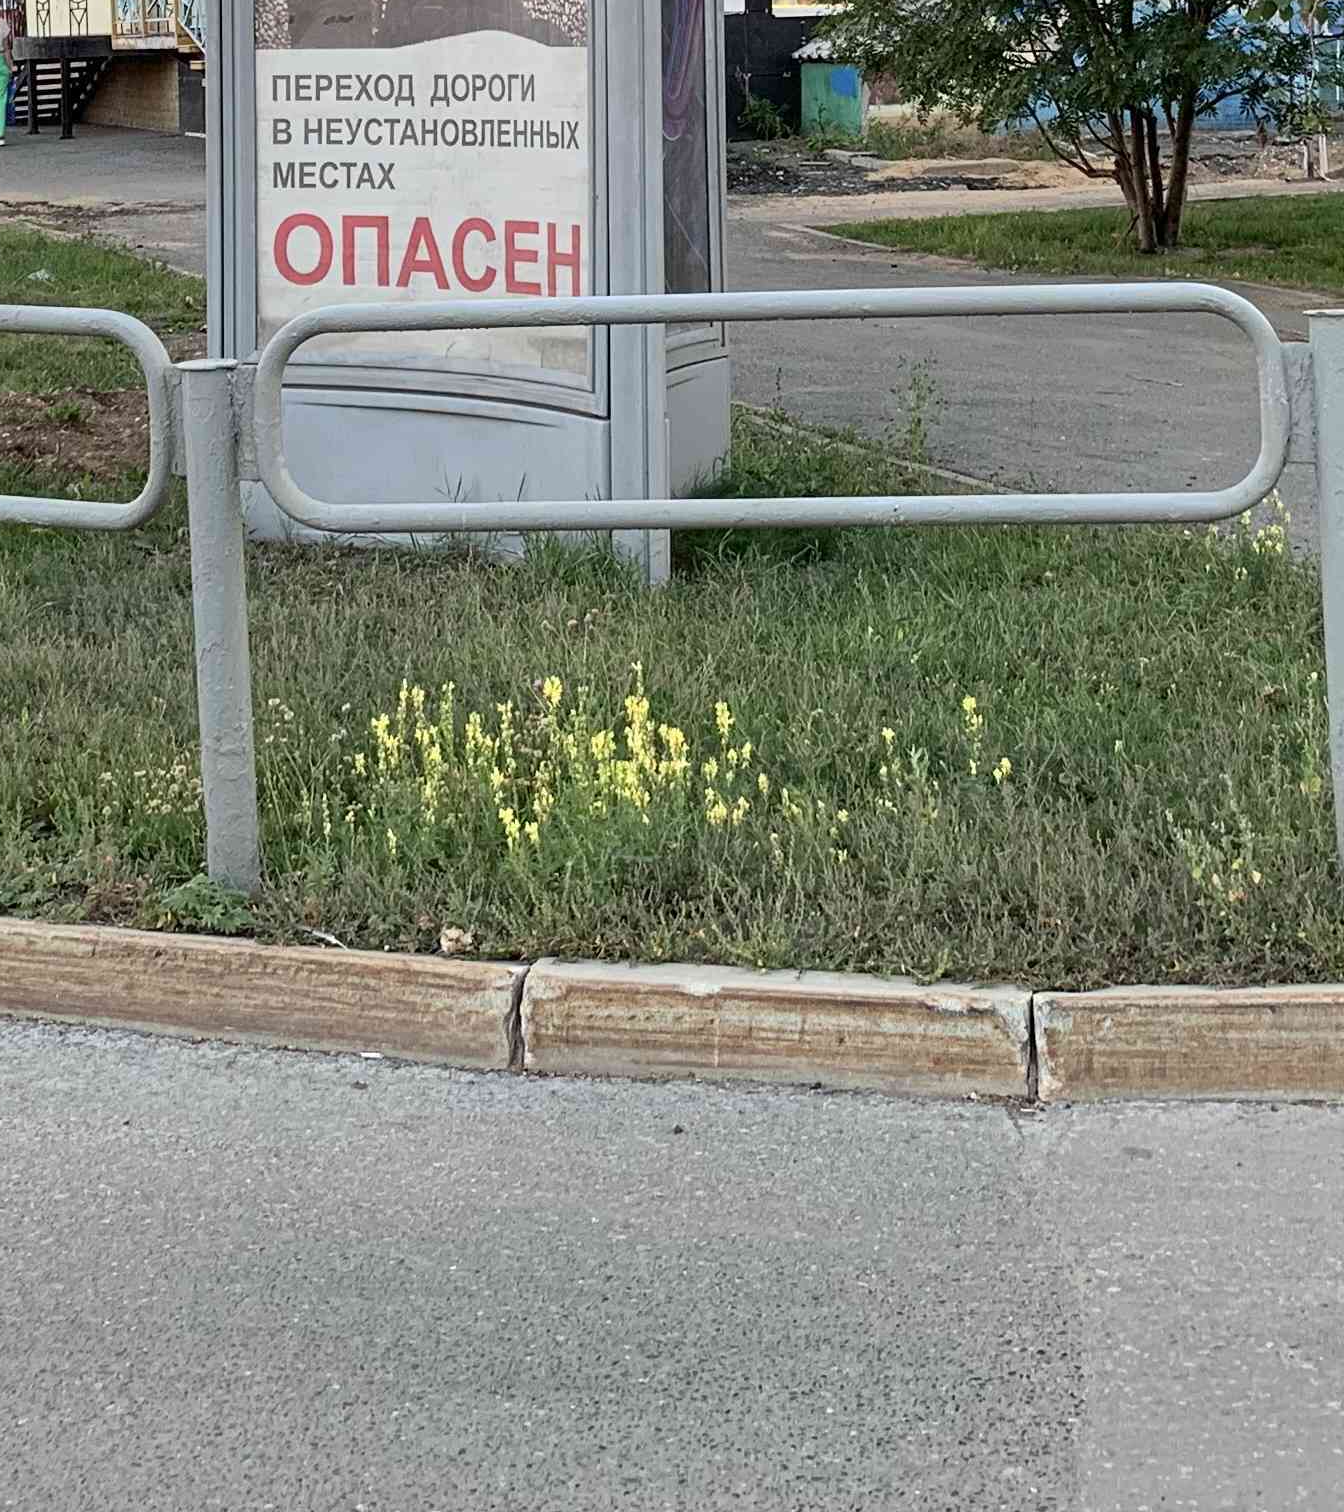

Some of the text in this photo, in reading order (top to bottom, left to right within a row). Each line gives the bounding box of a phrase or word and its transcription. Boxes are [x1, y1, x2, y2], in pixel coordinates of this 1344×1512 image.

[272, 74, 536, 107] ПЕРЕХОД ДОРОГИ
[272, 118, 580, 150] В НЕУСТАНОВЛЕННЫХ
[272, 161, 396, 190] МЕСТАХ
[273, 212, 582, 298] ОПАСЕН
